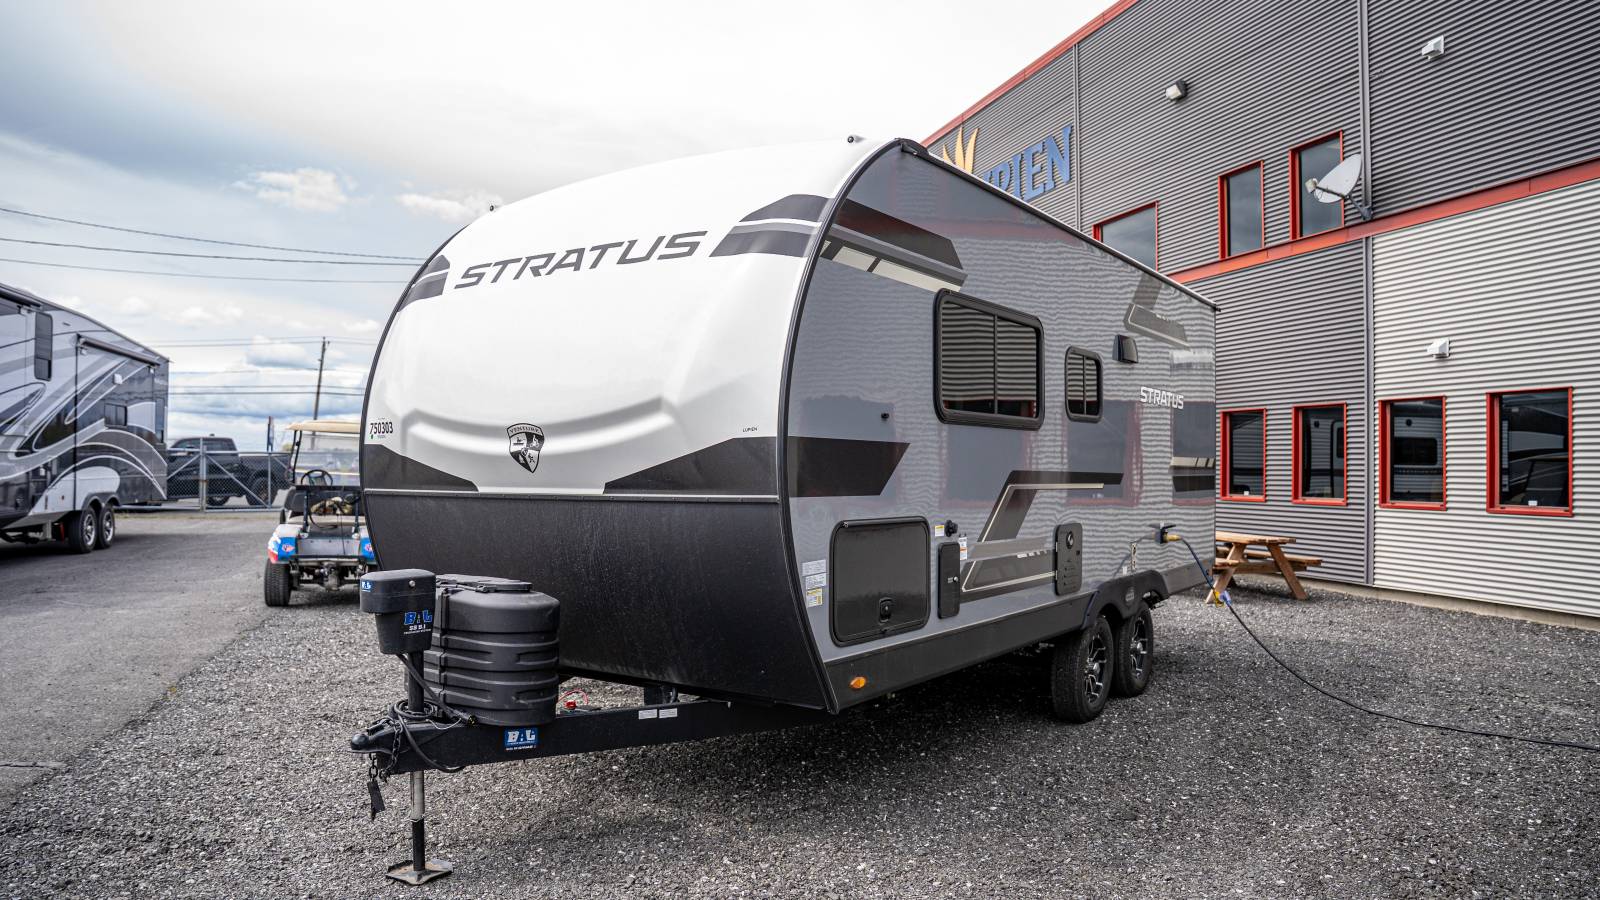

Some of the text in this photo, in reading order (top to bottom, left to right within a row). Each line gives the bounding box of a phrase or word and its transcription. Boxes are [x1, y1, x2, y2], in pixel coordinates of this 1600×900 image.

[454, 230, 708, 289] STRATUS
[1139, 386, 1185, 410] STRATUS
[369, 421, 394, 435] 750303
